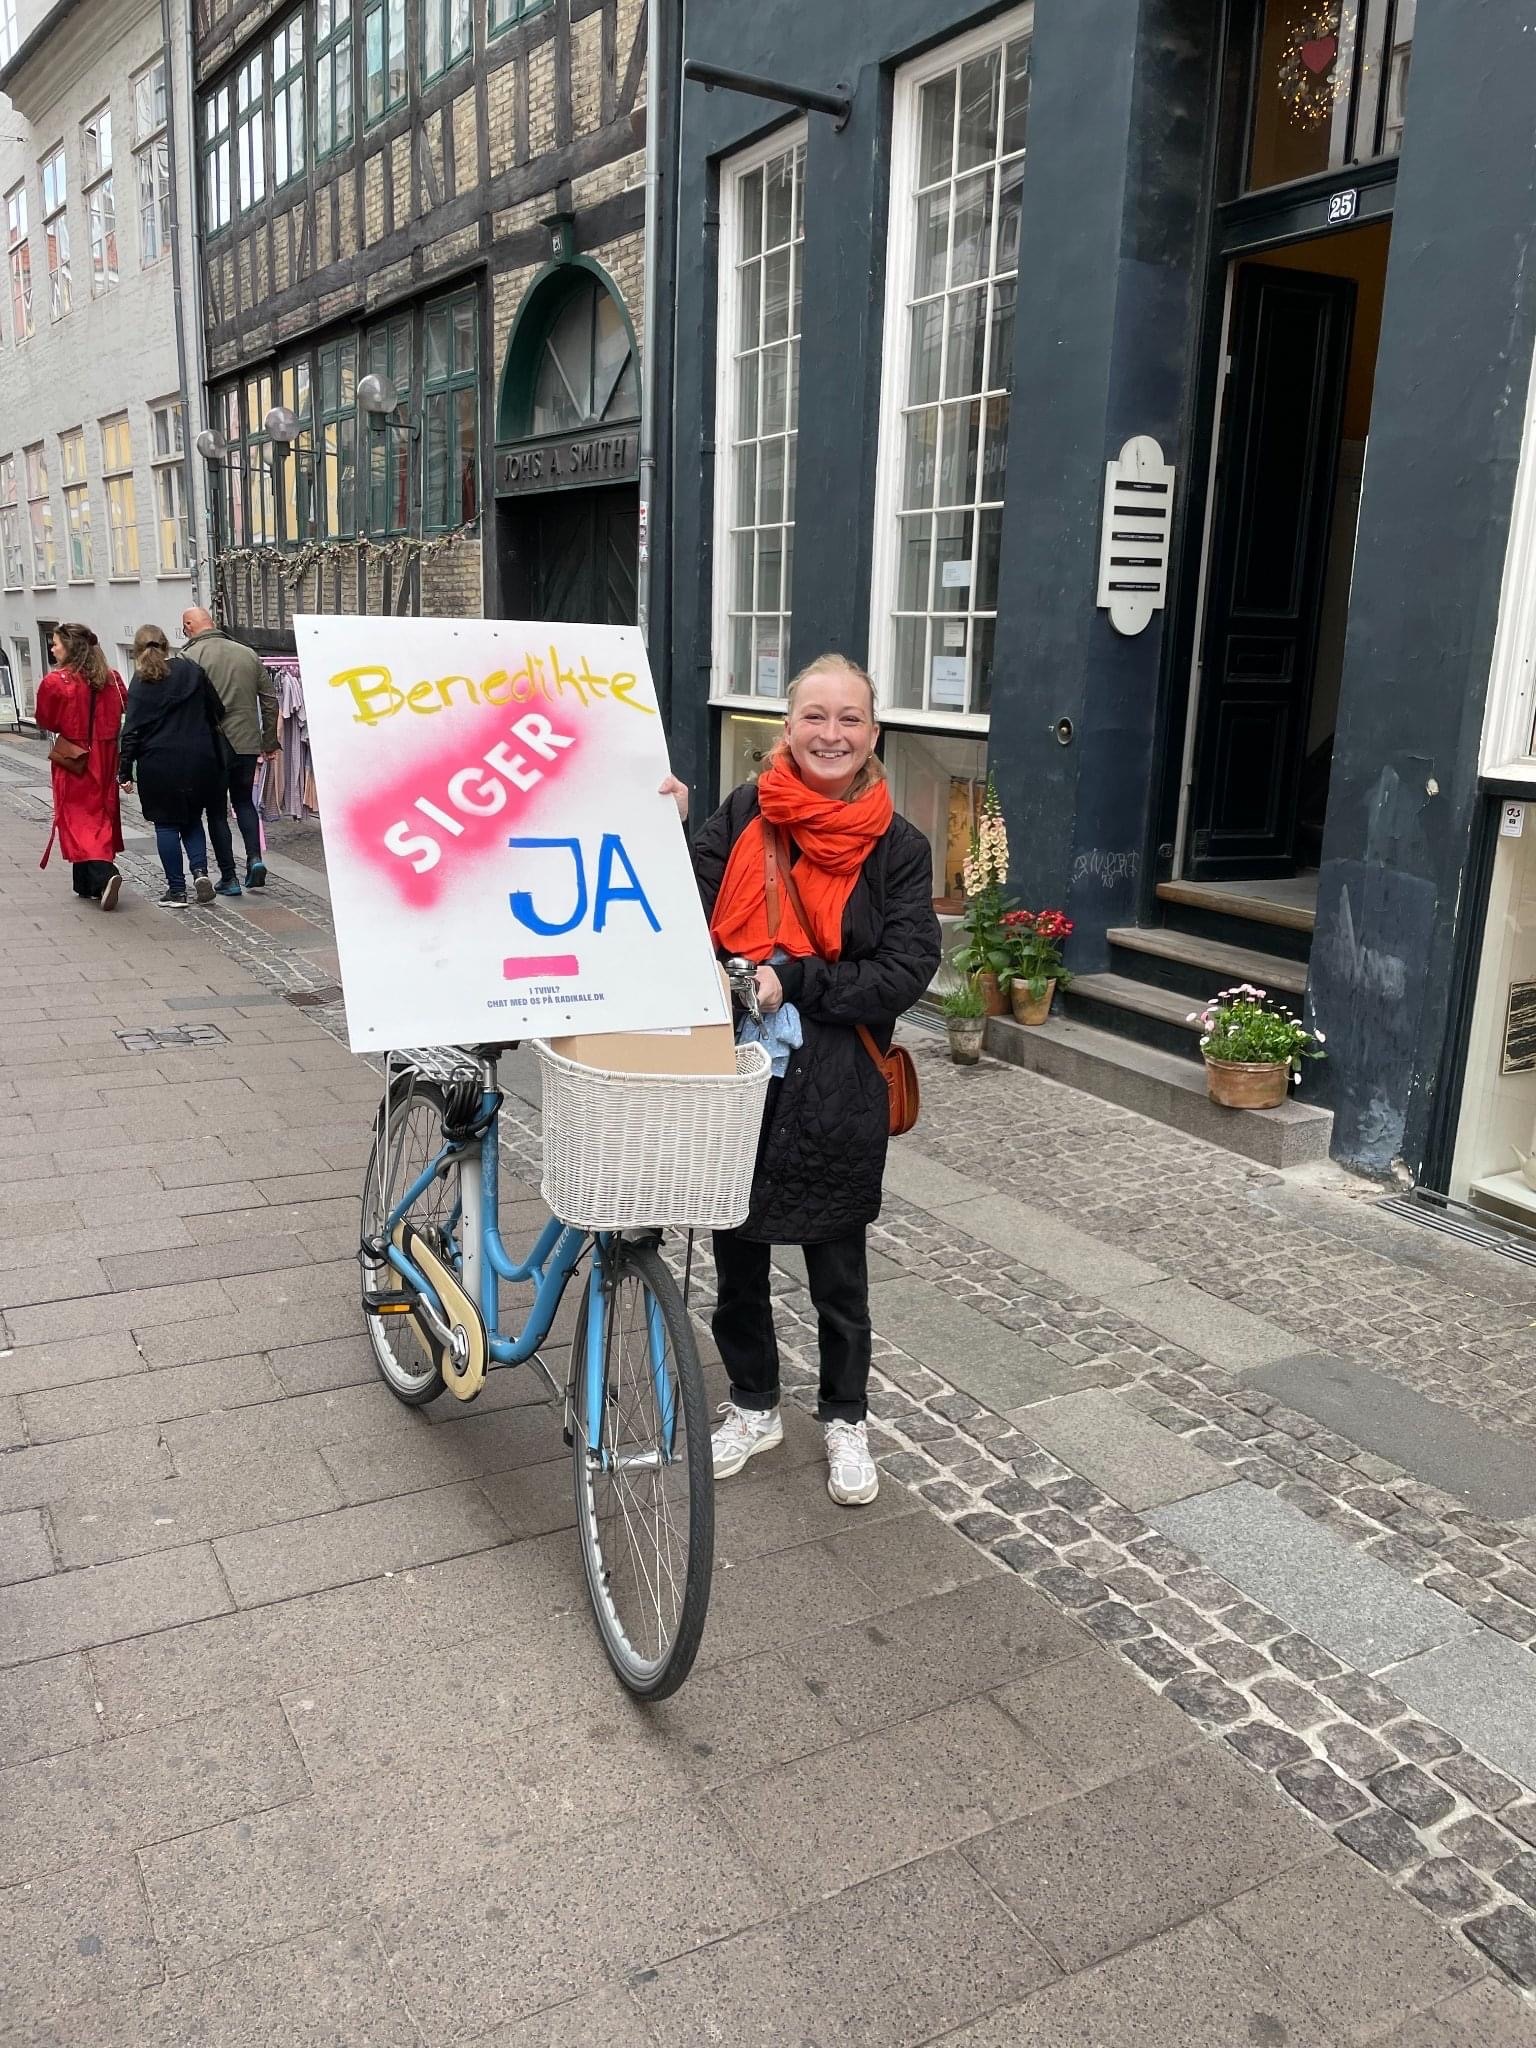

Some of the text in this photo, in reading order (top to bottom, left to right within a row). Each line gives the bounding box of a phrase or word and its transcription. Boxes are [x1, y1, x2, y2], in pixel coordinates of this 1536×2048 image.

[1330, 194, 1353, 219] 25
[569, 436, 627, 473] SMITH
[329, 645, 656, 727] Benedikte
[383, 712, 576, 875] SIGER
[508, 833, 662, 936] JA
[487, 993, 605, 1008] CHAT MED OS PÅ RADIKALE.DK
[534, 986, 560, 995] TVIVL?
